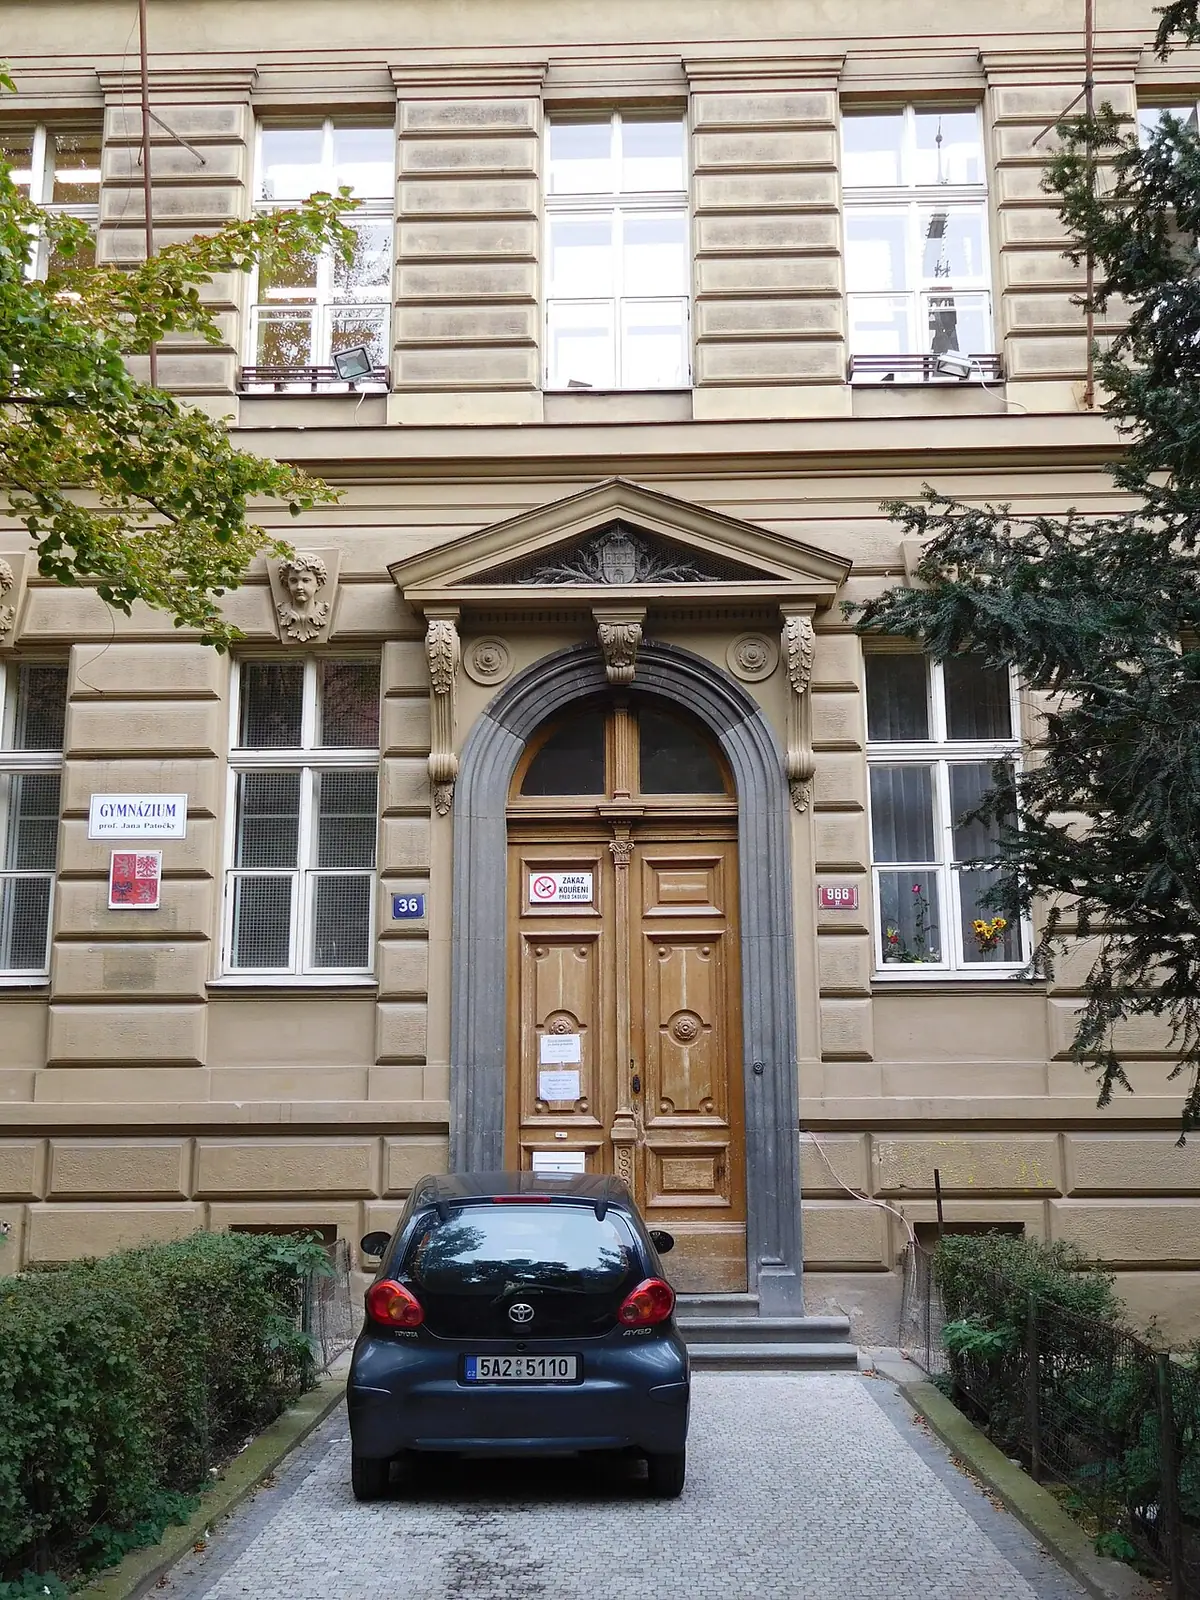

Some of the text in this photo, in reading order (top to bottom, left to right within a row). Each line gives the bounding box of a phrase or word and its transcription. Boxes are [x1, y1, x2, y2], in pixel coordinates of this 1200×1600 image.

[100, 801, 176, 817] GYMNÁZIUM
[144, 822, 175, 830] Patočky
[827, 888, 849, 900] 966
[398, 898, 418, 912] 36
[394, 1330, 418, 1338] TOYOTA
[622, 1328, 652, 1336] AYGO
[480, 1359, 568, 1377] 5A2 5110
